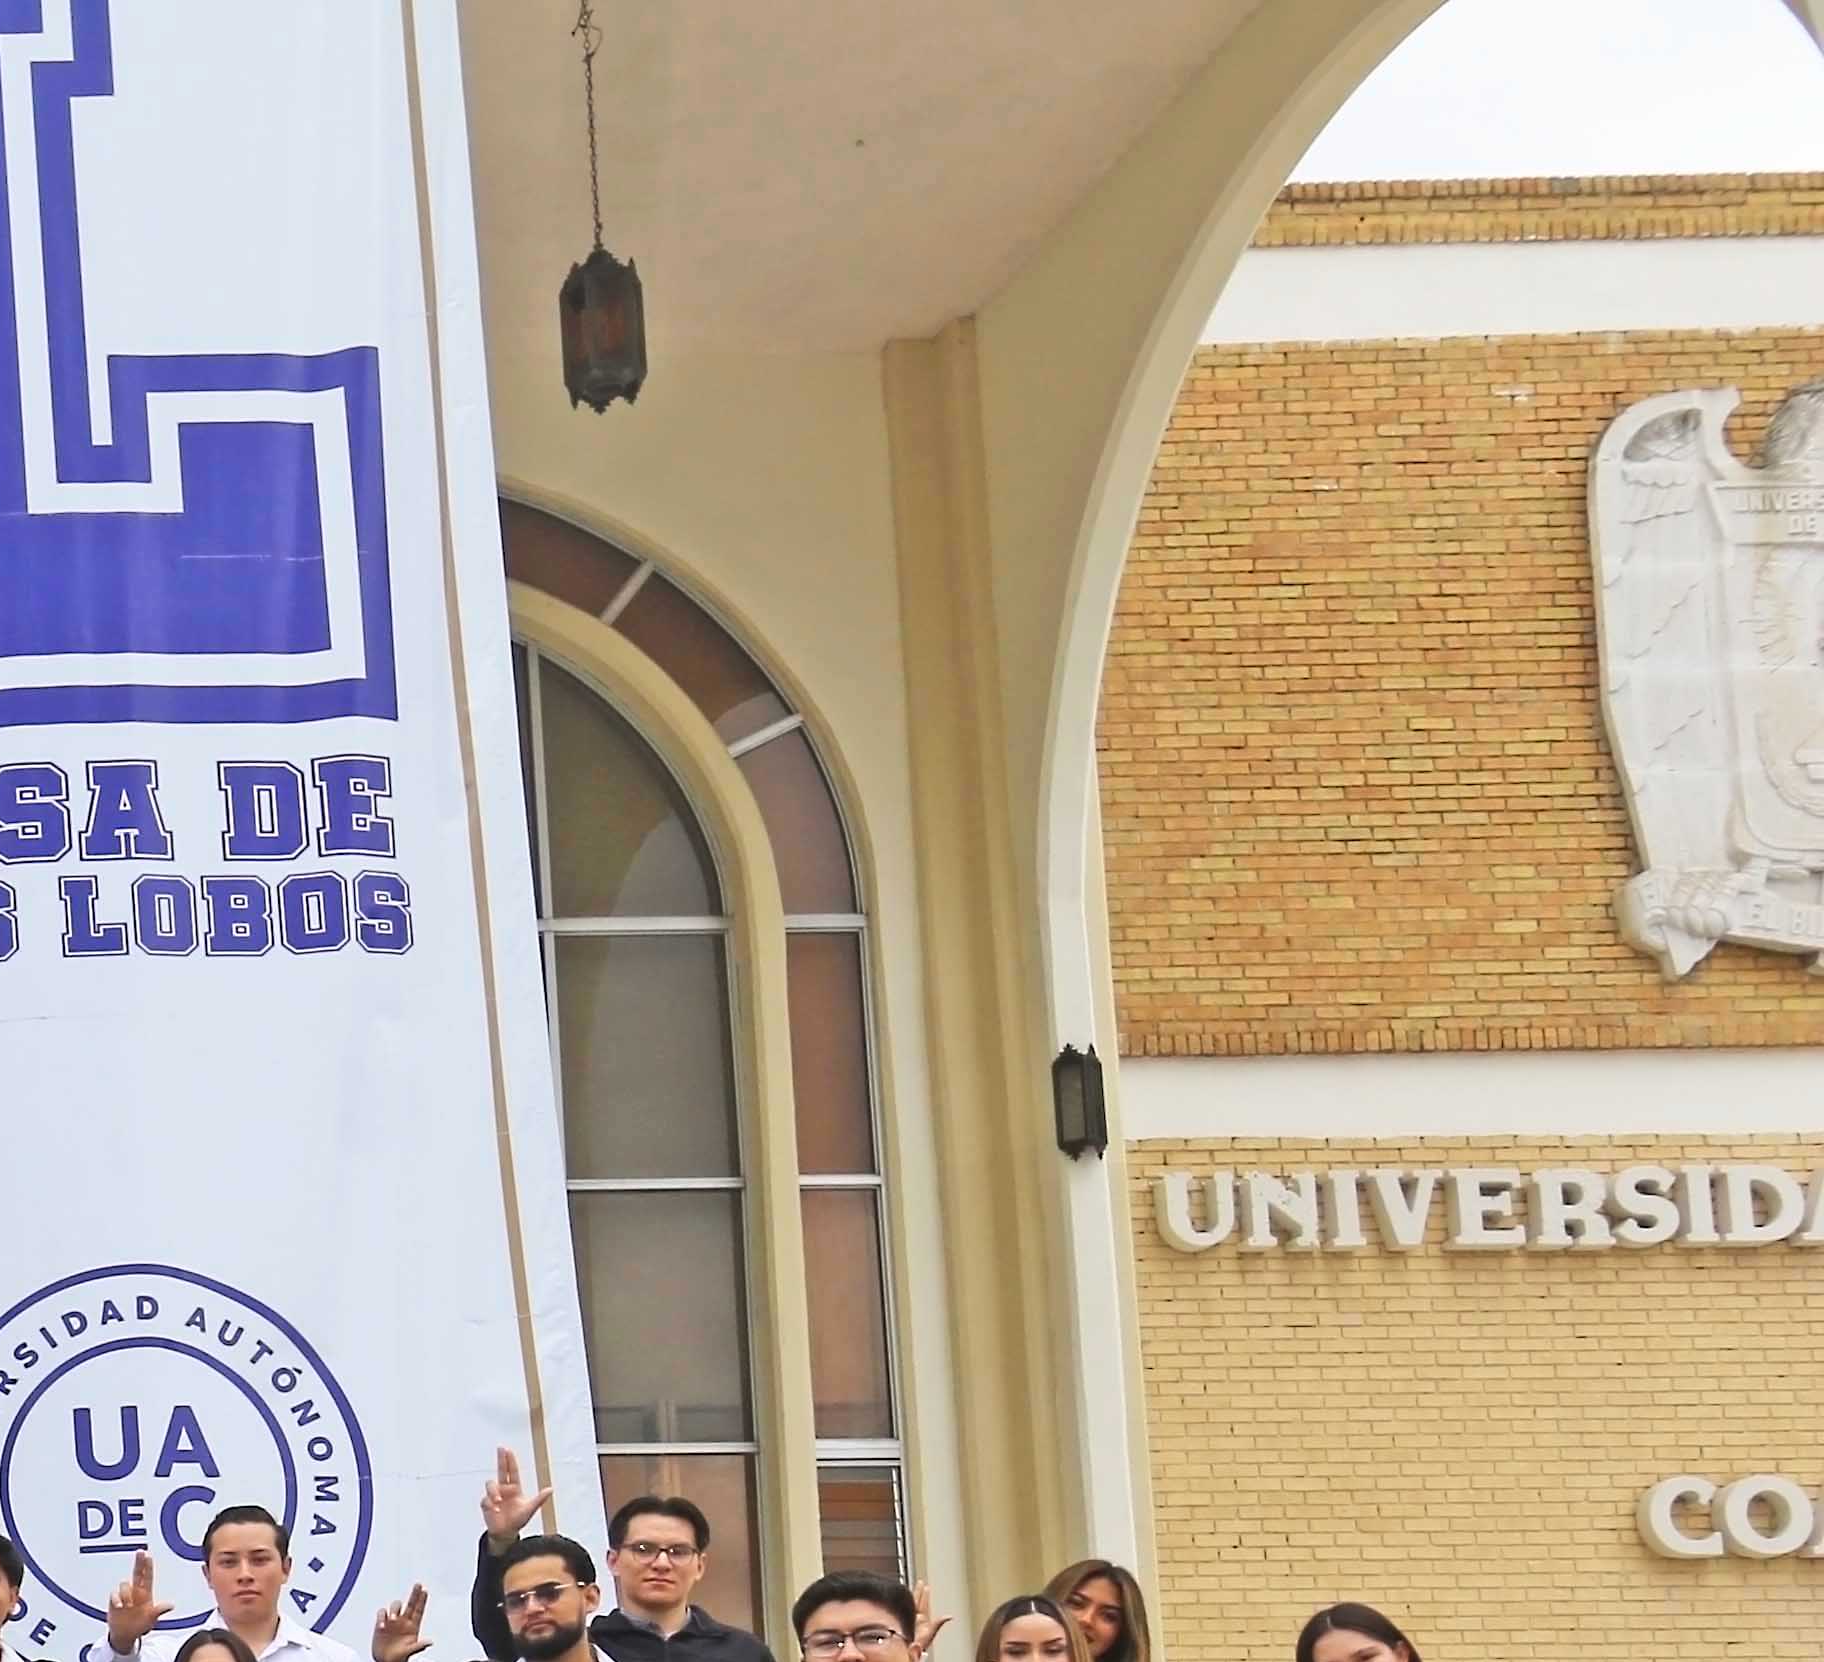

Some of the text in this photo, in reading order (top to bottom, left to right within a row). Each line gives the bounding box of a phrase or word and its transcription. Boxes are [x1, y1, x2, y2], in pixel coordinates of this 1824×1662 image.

[217, 753, 396, 862] DE
[59, 869, 414, 959] LOBOS
[72, 1404, 221, 1482] UA
[184, 1306, 340, 1537] AUTÓNOMA
[76, 1484, 217, 1563] DE C
[1639, 1474, 1824, 1560] CO
